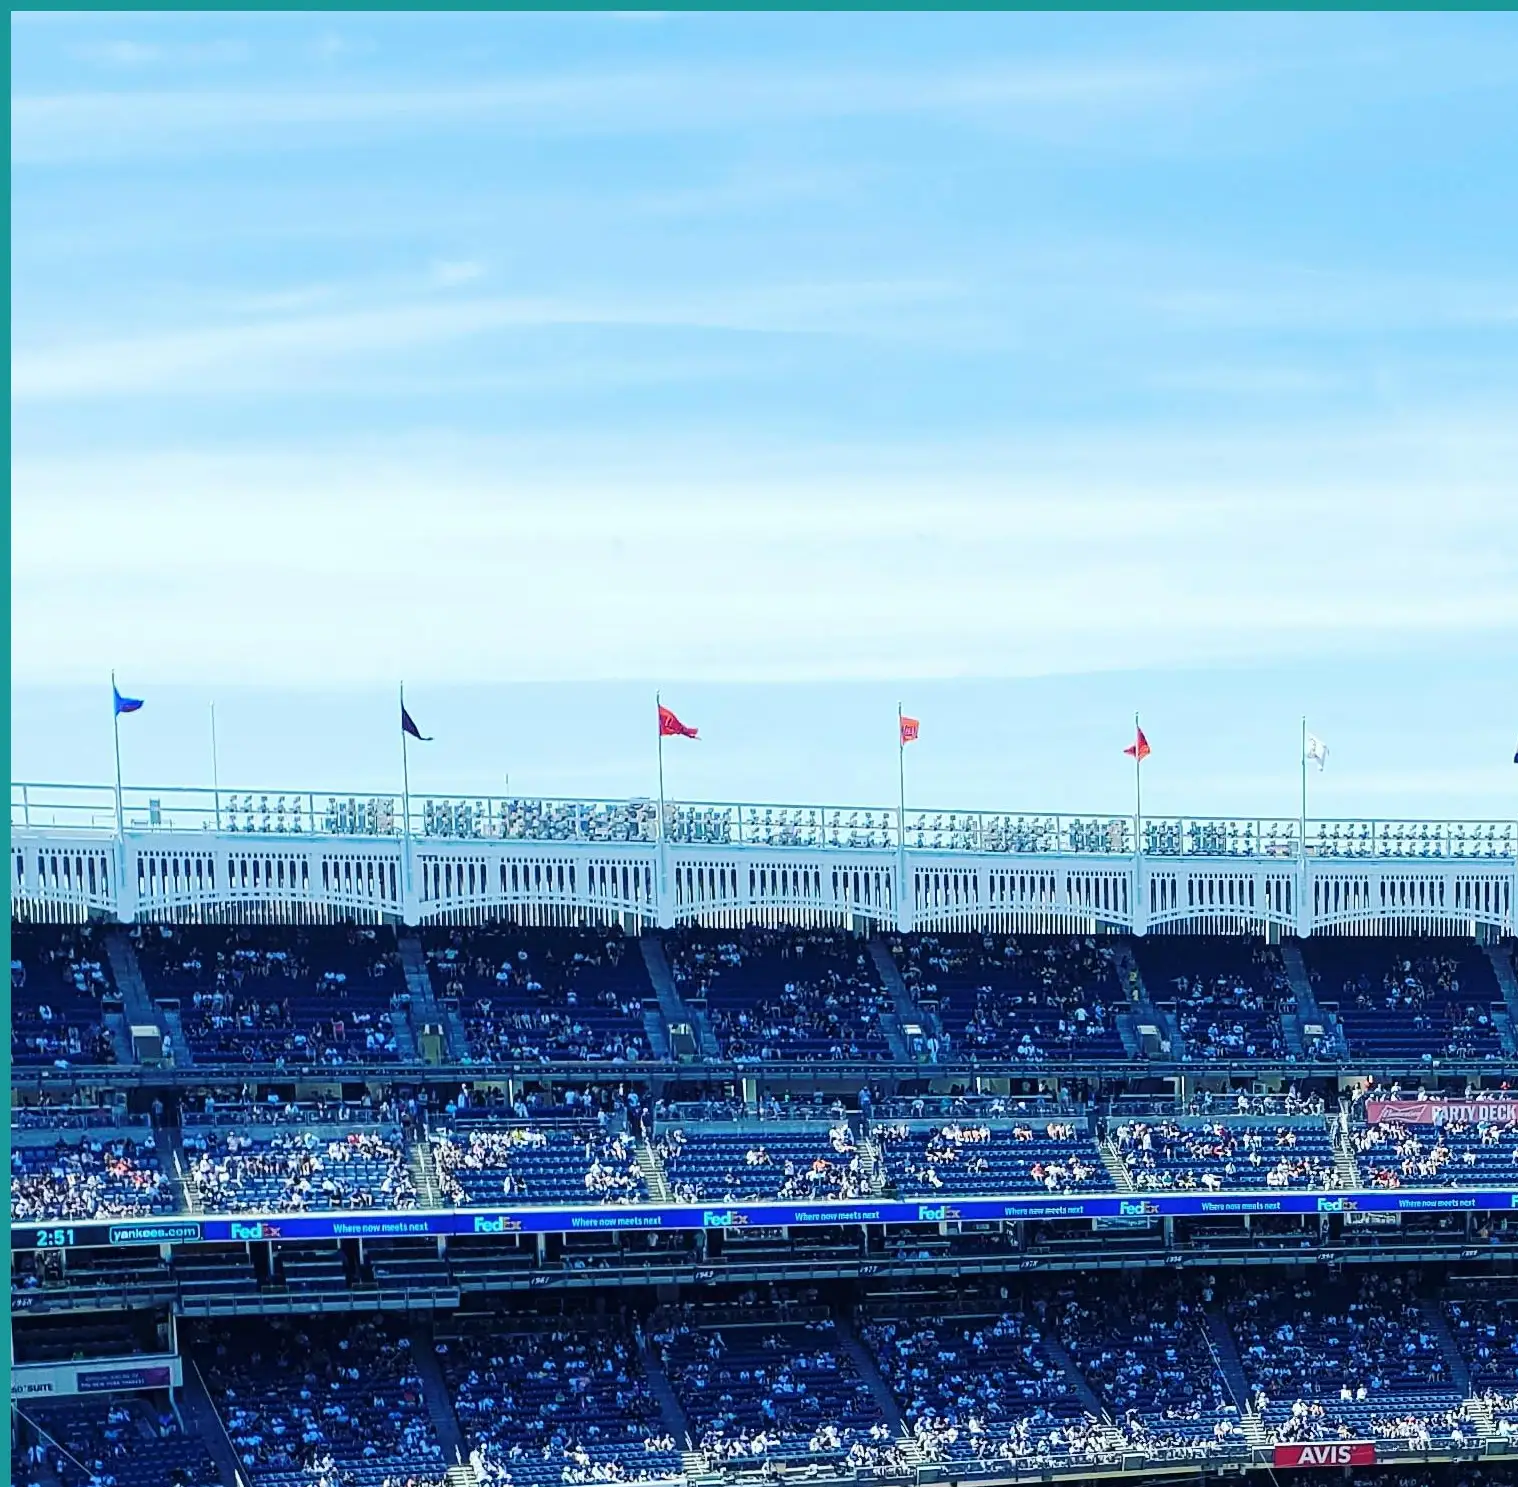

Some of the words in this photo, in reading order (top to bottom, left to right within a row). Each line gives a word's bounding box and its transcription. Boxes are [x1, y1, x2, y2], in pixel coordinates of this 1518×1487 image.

[1432, 1105, 1477, 1122] PARTY
[1478, 1105, 1517, 1121] DECK
[1120, 1201, 1159, 1215] FedEx
[1318, 1198, 1357, 1211] FedEx
[704, 1211, 748, 1226] FedEx
[795, 1212, 820, 1221] Where
[821, 1213, 837, 1221] now
[838, 1212, 861, 1220] meets
[862, 1211, 879, 1219] next
[919, 1206, 960, 1220] FedEx
[333, 1223, 361, 1234] Where
[363, 1224, 381, 1232] now
[382, 1222, 407, 1232] meets
[409, 1221, 428, 1231] next
[474, 1216, 522, 1232] FedEx
[572, 1217, 598, 1227] Where
[599, 1218, 616, 1226] now
[617, 1217, 643, 1226] meets
[643, 1216, 661, 1225] next
[36, 1229, 74, 1247] 2:51
[113, 1226, 196, 1242] yankees.com
[231, 1222, 281, 1239] FedEx
[1297, 1445, 1352, 1465] AVIS
